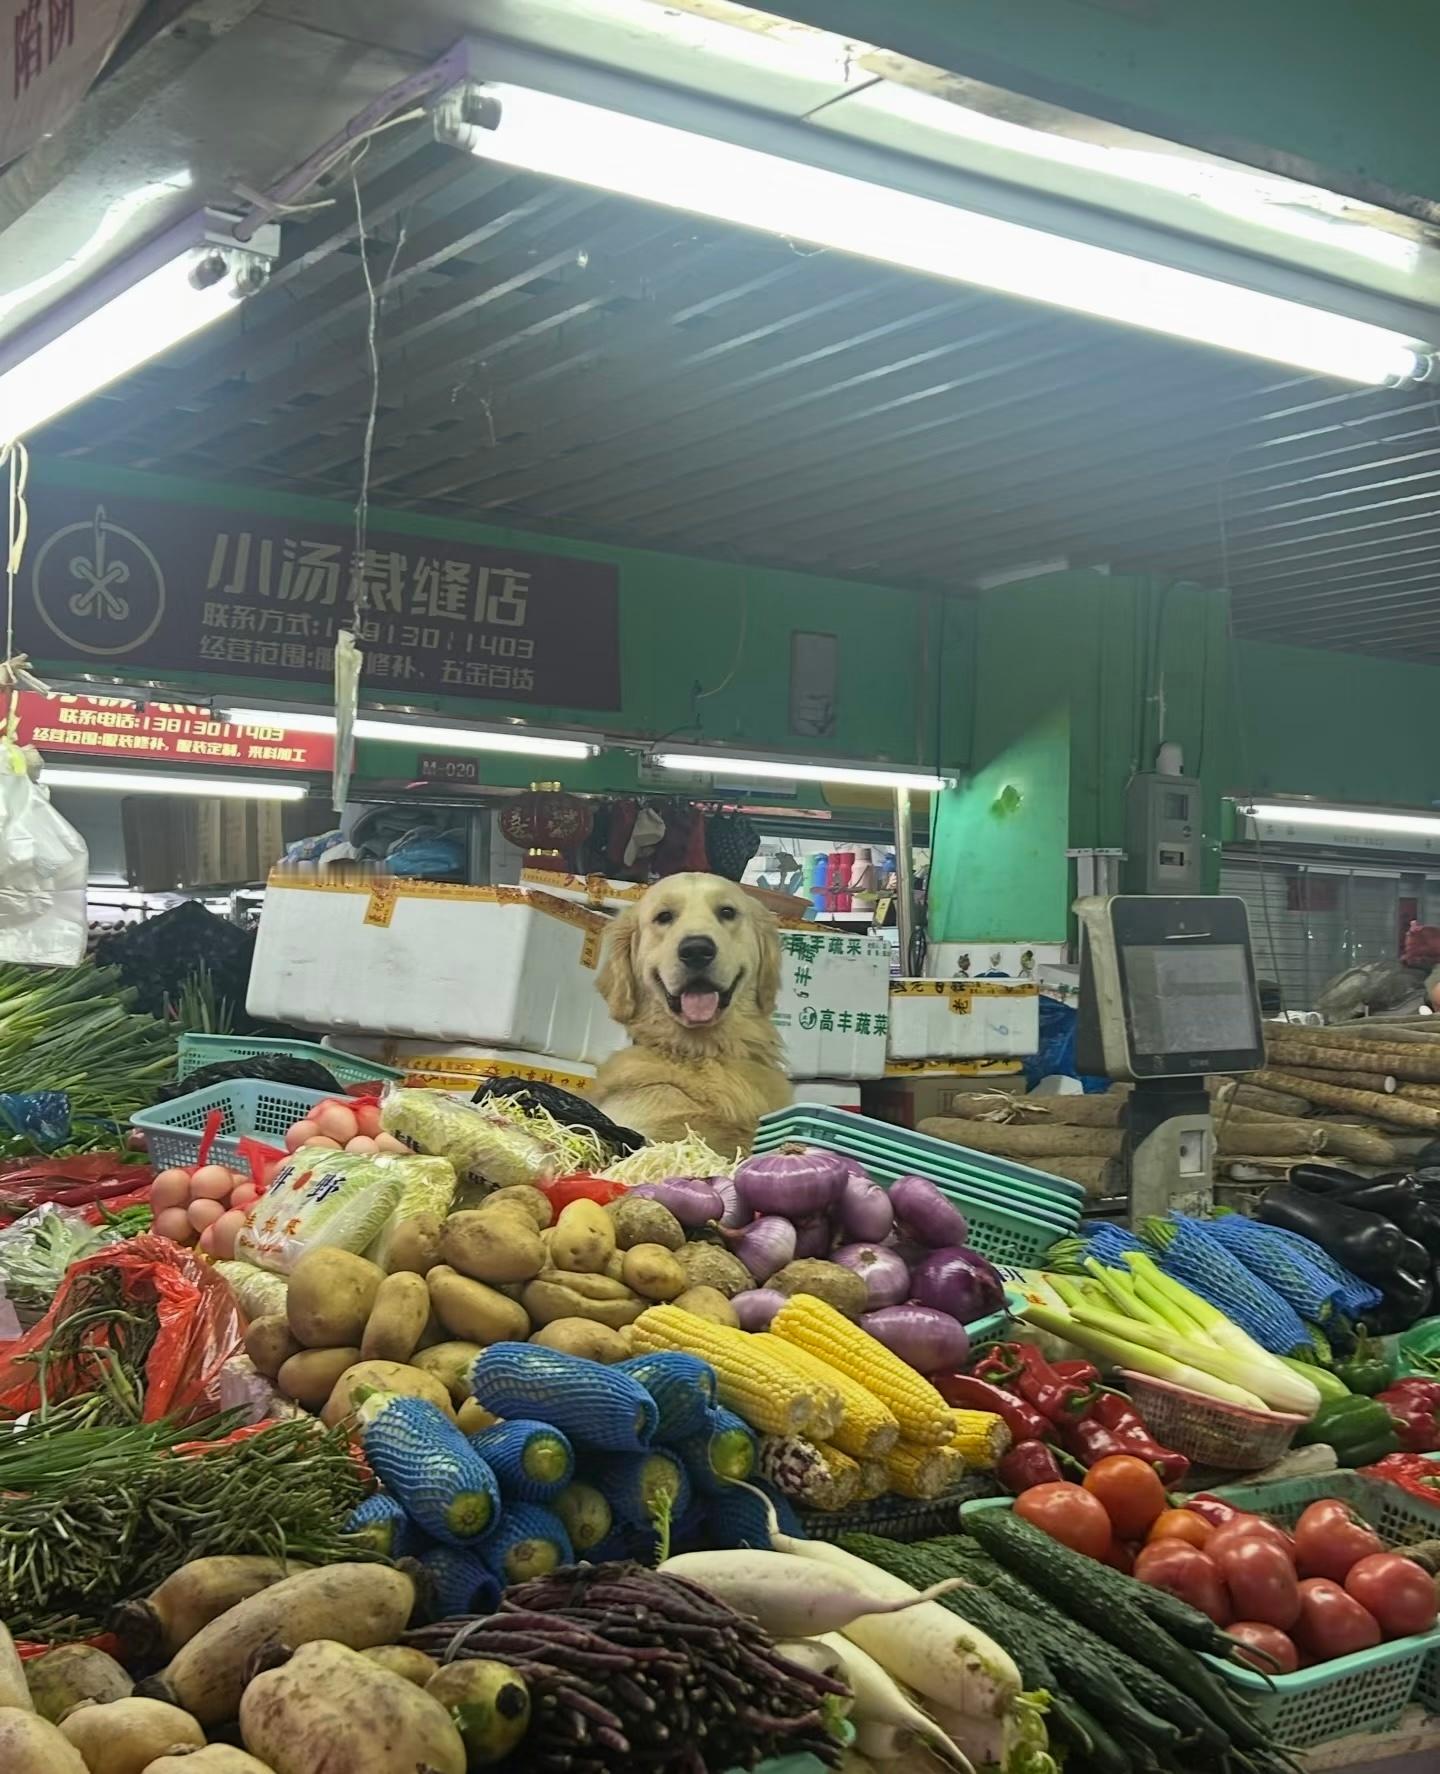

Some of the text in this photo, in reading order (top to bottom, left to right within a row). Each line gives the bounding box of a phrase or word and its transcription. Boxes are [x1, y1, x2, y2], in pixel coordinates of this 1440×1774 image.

[206, 531, 533, 628] 小汤裁缝店
[422, 760, 476, 778] M-020
[819, 1008, 889, 1037] 高丰蔬菜
